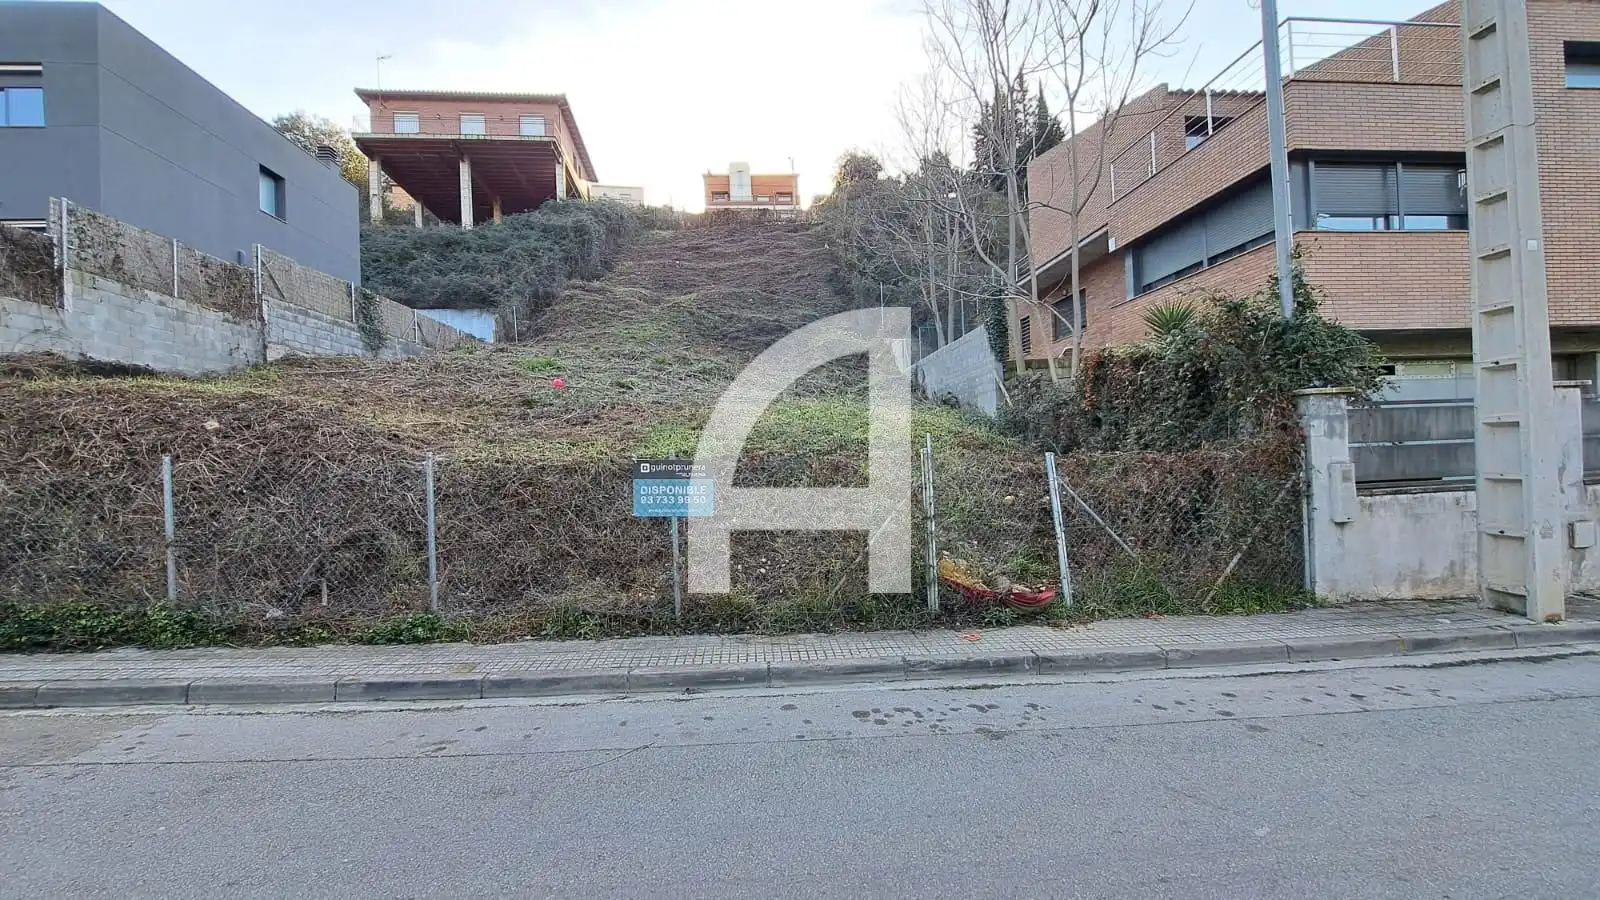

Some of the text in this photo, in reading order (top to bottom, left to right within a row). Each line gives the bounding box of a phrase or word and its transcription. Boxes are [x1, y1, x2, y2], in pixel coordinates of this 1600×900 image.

[640, 485, 707, 495] DISPONIBLE
[656, 495, 675, 504] 733
[693, 495, 706, 504] 50
